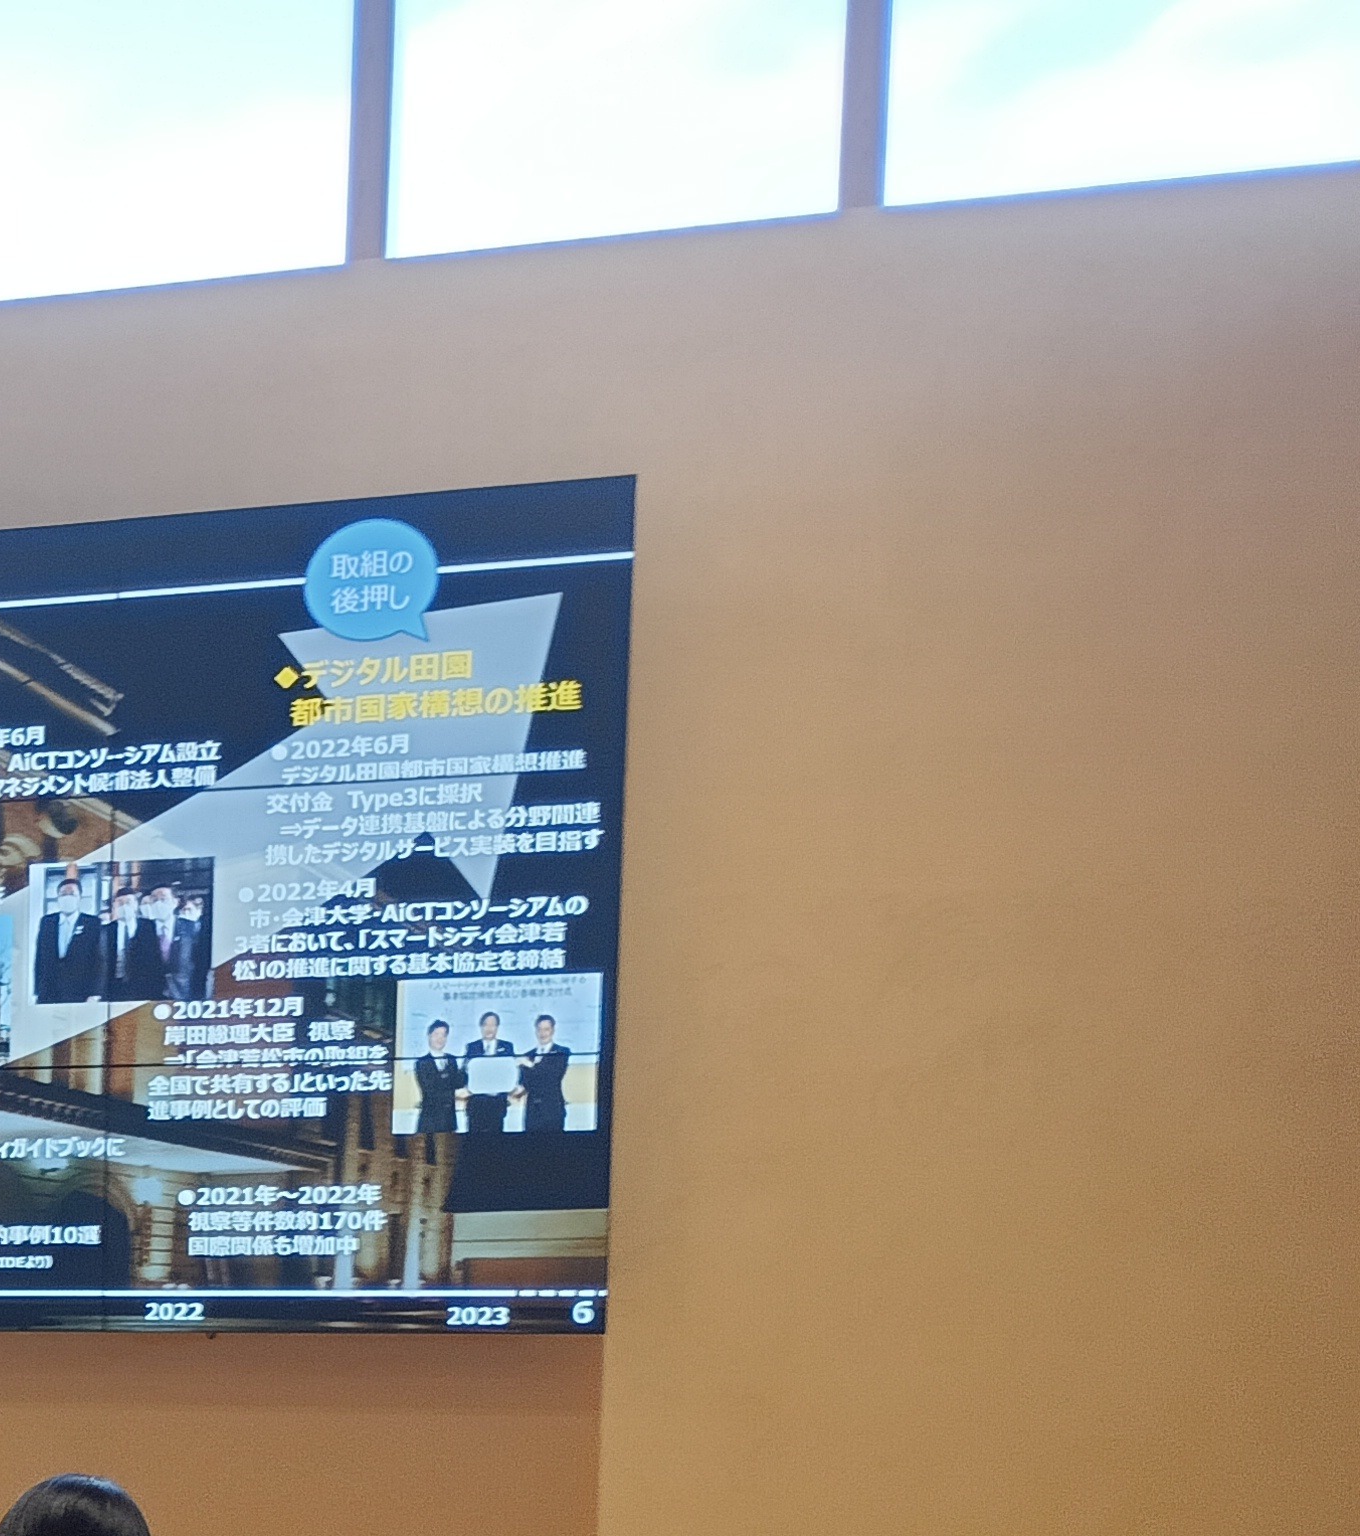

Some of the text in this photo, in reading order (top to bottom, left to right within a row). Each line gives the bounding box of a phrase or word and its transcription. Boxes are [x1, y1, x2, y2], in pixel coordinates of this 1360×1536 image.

[331, 550, 412, 580] 取組の
[331, 584, 409, 614] 後押し
[301, 650, 472, 688] デジタル田園
[291, 679, 583, 726] 都市国家構想の推進
[293, 733, 410, 760] 2022年6月
[282, 749, 587, 786] デジタル田園都市国家構想推進
[266, 783, 482, 814] 交付金 Type3に採択
[265, 828, 604, 866] 携したデジタルサービス実装を目指す
[258, 878, 376, 902] 2022年4月
[232, 949, 565, 981] 松」の推進に関する基本協定を締結
[173, 997, 304, 1020] 2021年12月
[164, 1020, 355, 1045] 岸田総理大臣 視察
[148, 1071, 392, 1097] 全国で共有する」といった先
[148, 1098, 326, 1121] 進事例としての評価
[189, 1210, 387, 1231] 視察等件数約170件
[188, 1236, 359, 1256] 国際関係も増加中
[144, 1302, 205, 1321] 2022
[446, 1307, 510, 1326] 2023
[572, 1300, 595, 1324] 6
